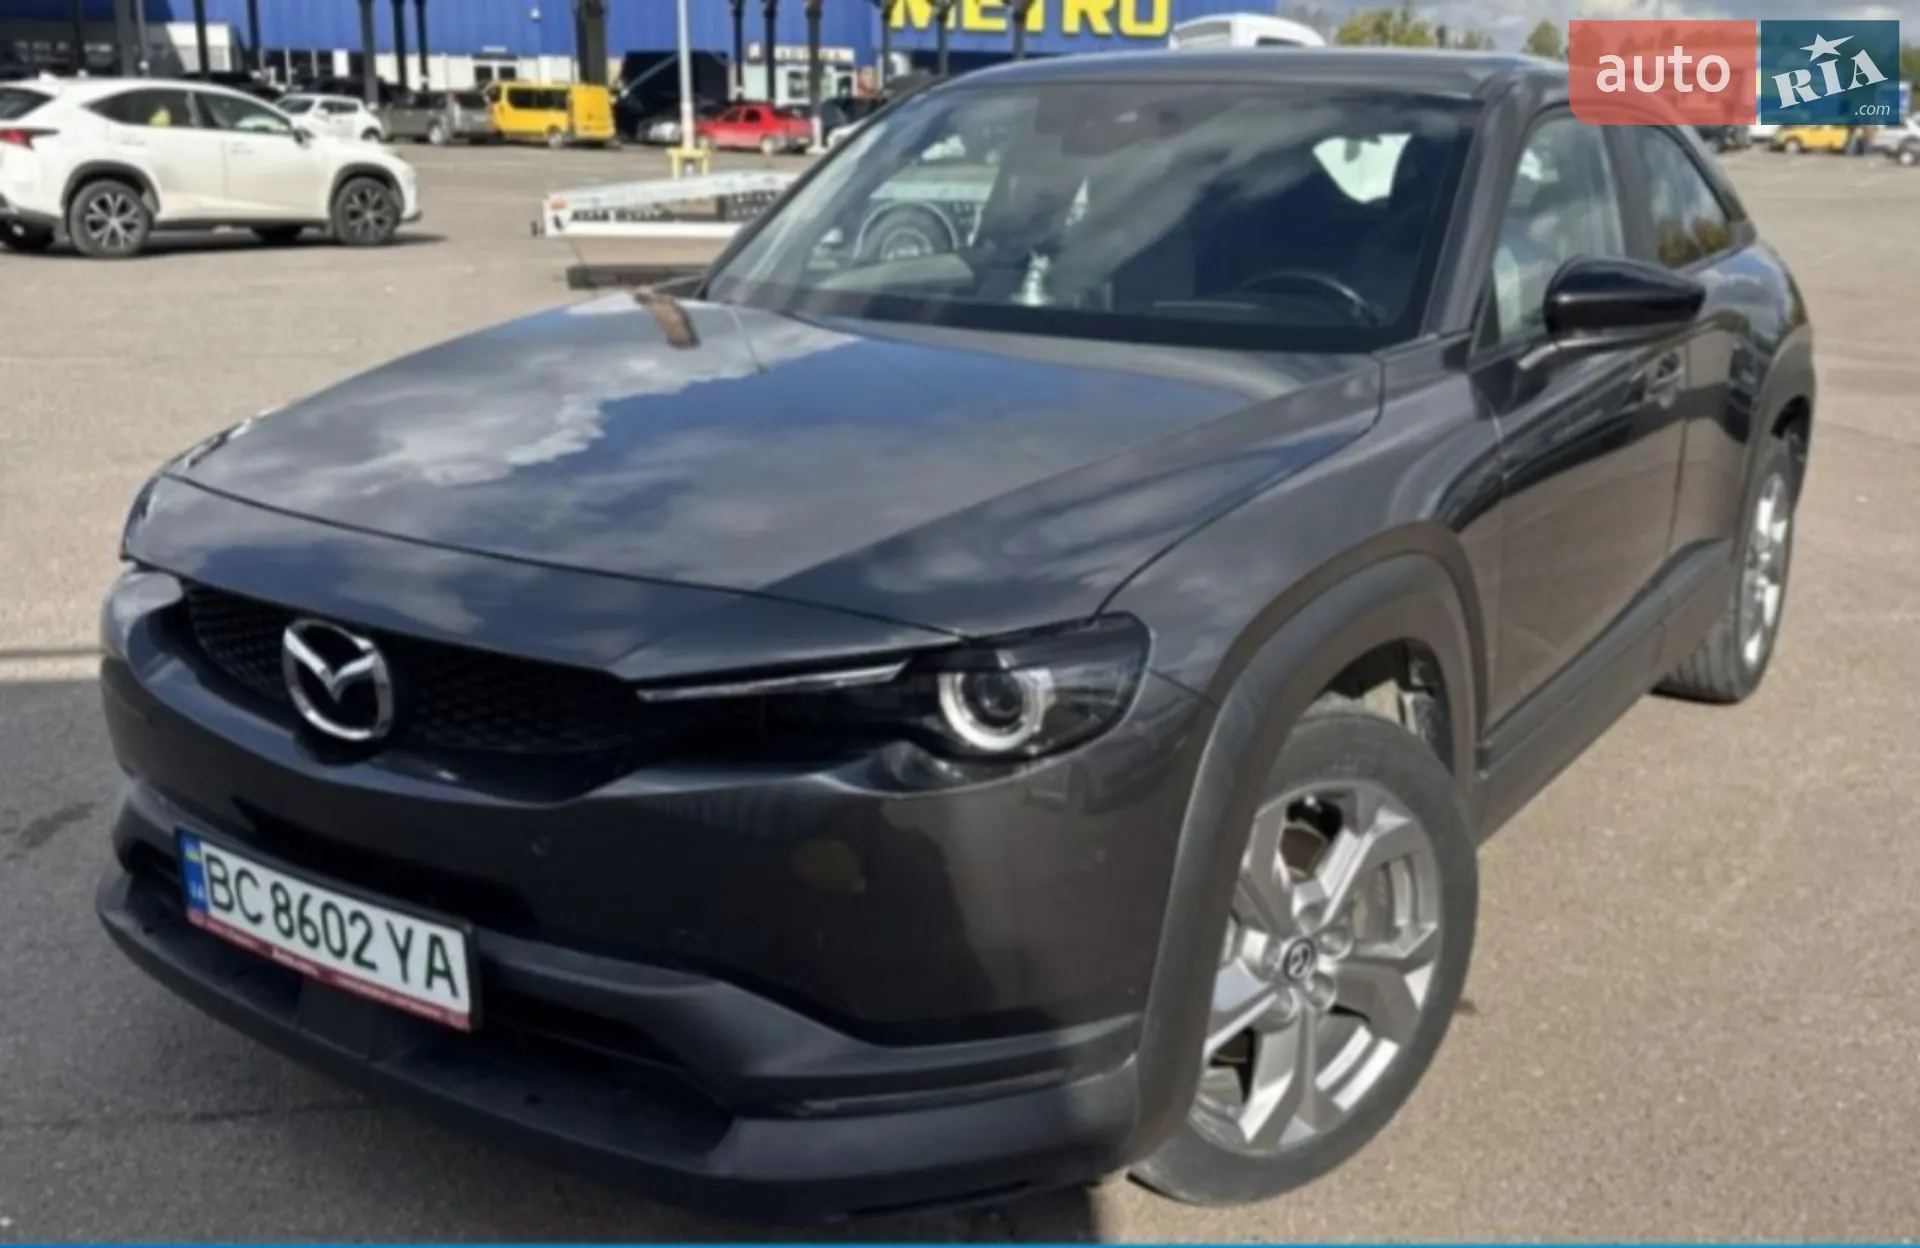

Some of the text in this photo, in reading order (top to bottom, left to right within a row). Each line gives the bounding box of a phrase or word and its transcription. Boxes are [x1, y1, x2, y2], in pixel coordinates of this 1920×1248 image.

[204, 852, 265, 926] BC
[270, 881, 378, 972] 8602
[386, 919, 459, 998] YA
